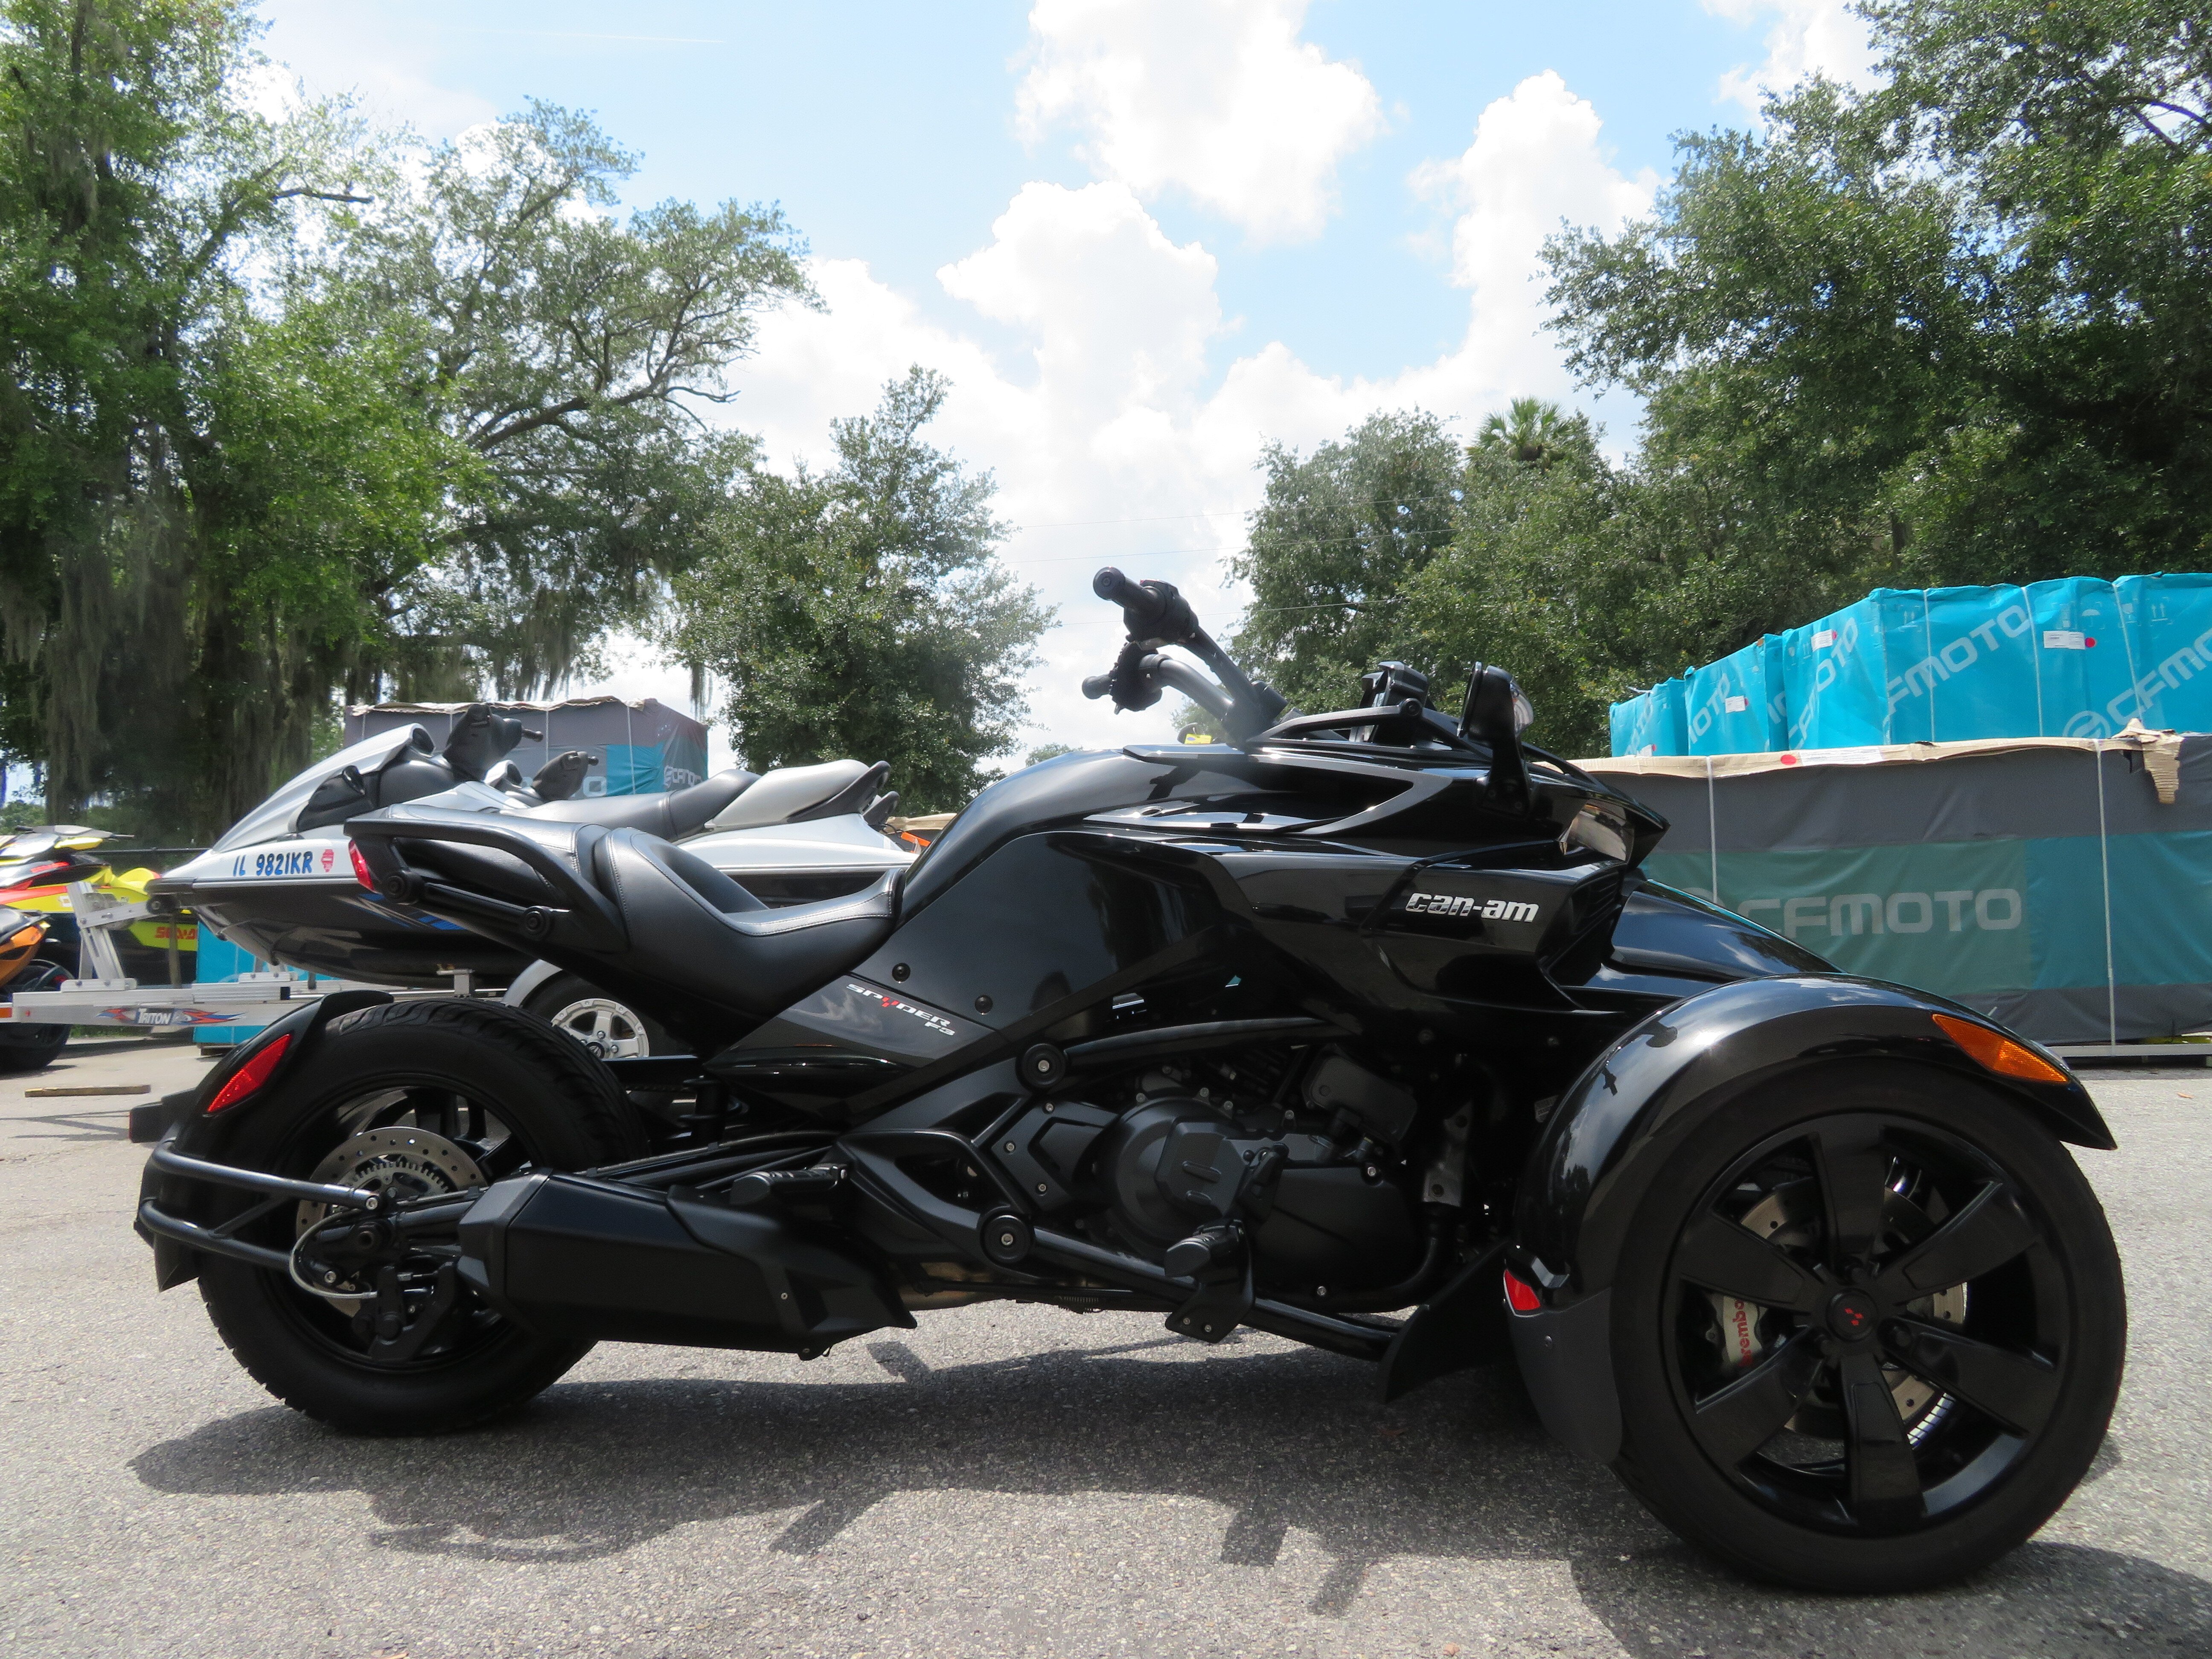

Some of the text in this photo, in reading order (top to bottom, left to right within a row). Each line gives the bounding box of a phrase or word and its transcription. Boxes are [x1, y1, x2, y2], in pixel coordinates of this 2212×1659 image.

[233, 855, 246, 876] IL
[256, 851, 313, 876] 9821KR
[1406, 893, 1539, 922] can-am
[1738, 889, 2022, 939] CFMOTO
[137, 1007, 171, 1024] TRITON
[846, 984, 951, 1027] SPYDER
[924, 1022, 955, 1036] F3
